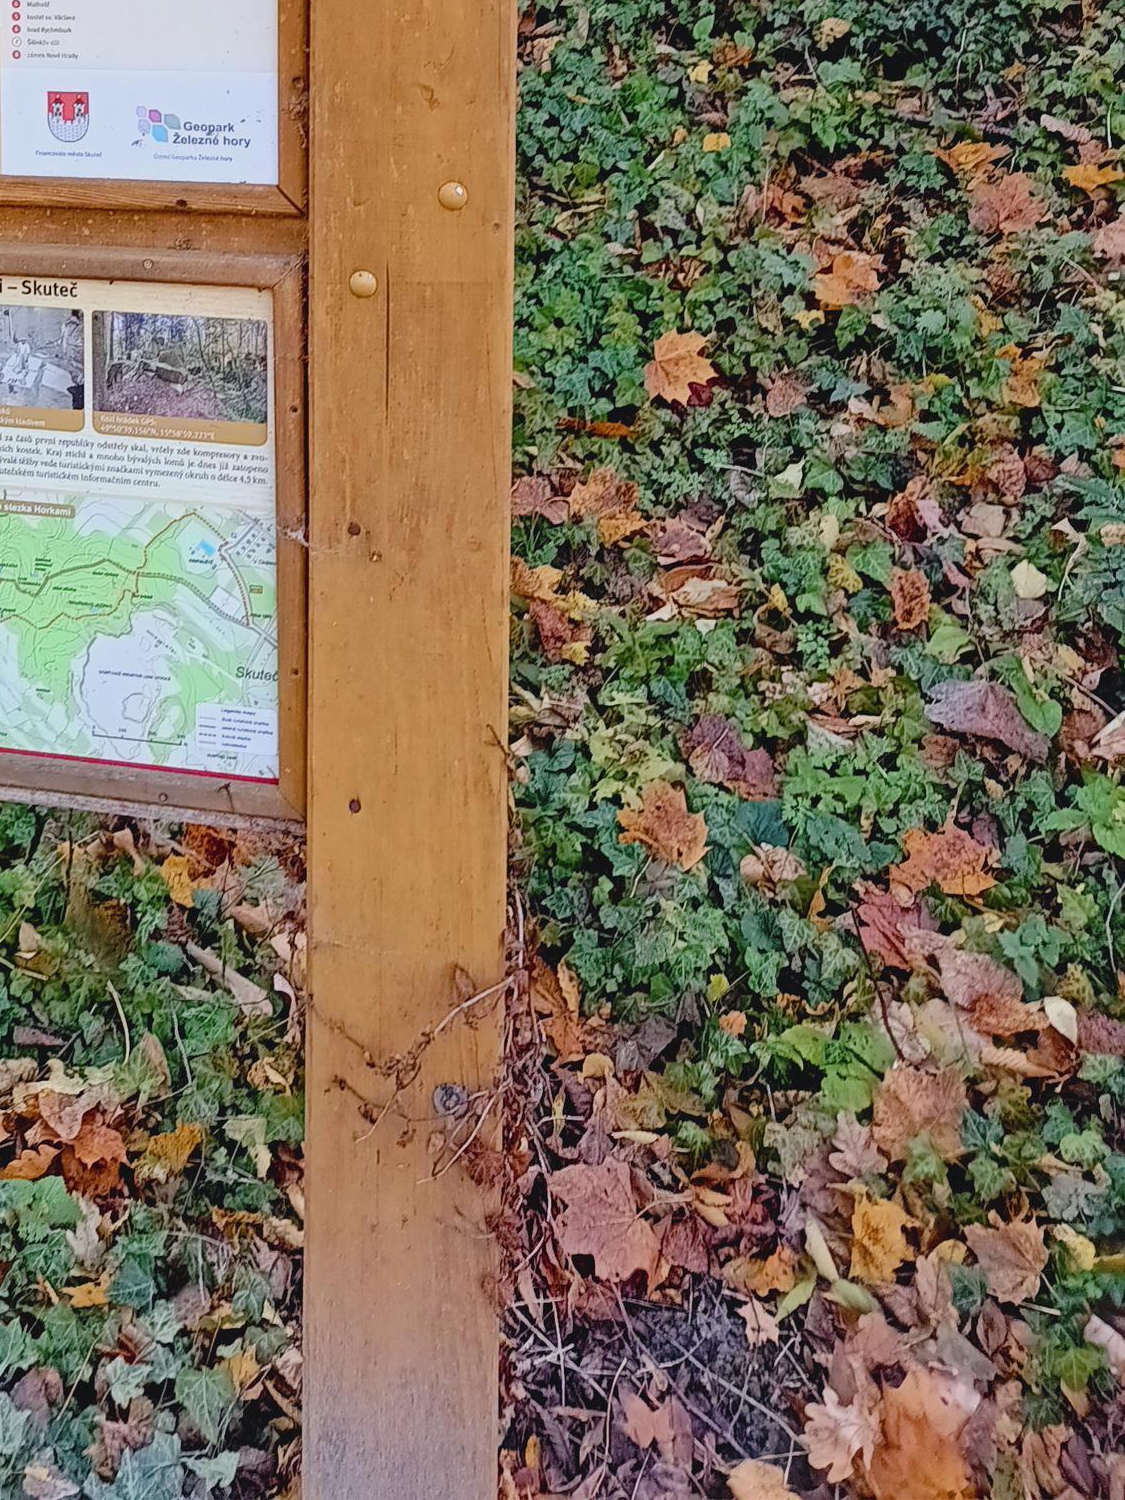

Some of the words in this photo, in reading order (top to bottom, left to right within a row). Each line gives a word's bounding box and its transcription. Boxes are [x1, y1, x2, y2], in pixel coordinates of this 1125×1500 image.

[183, 121, 234, 135] Geopark
[172, 133, 219, 145] Železné
[222, 135, 250, 148] hory
[21, 279, 77, 297] Skuteč
[35, 504, 71, 516] Horkami
